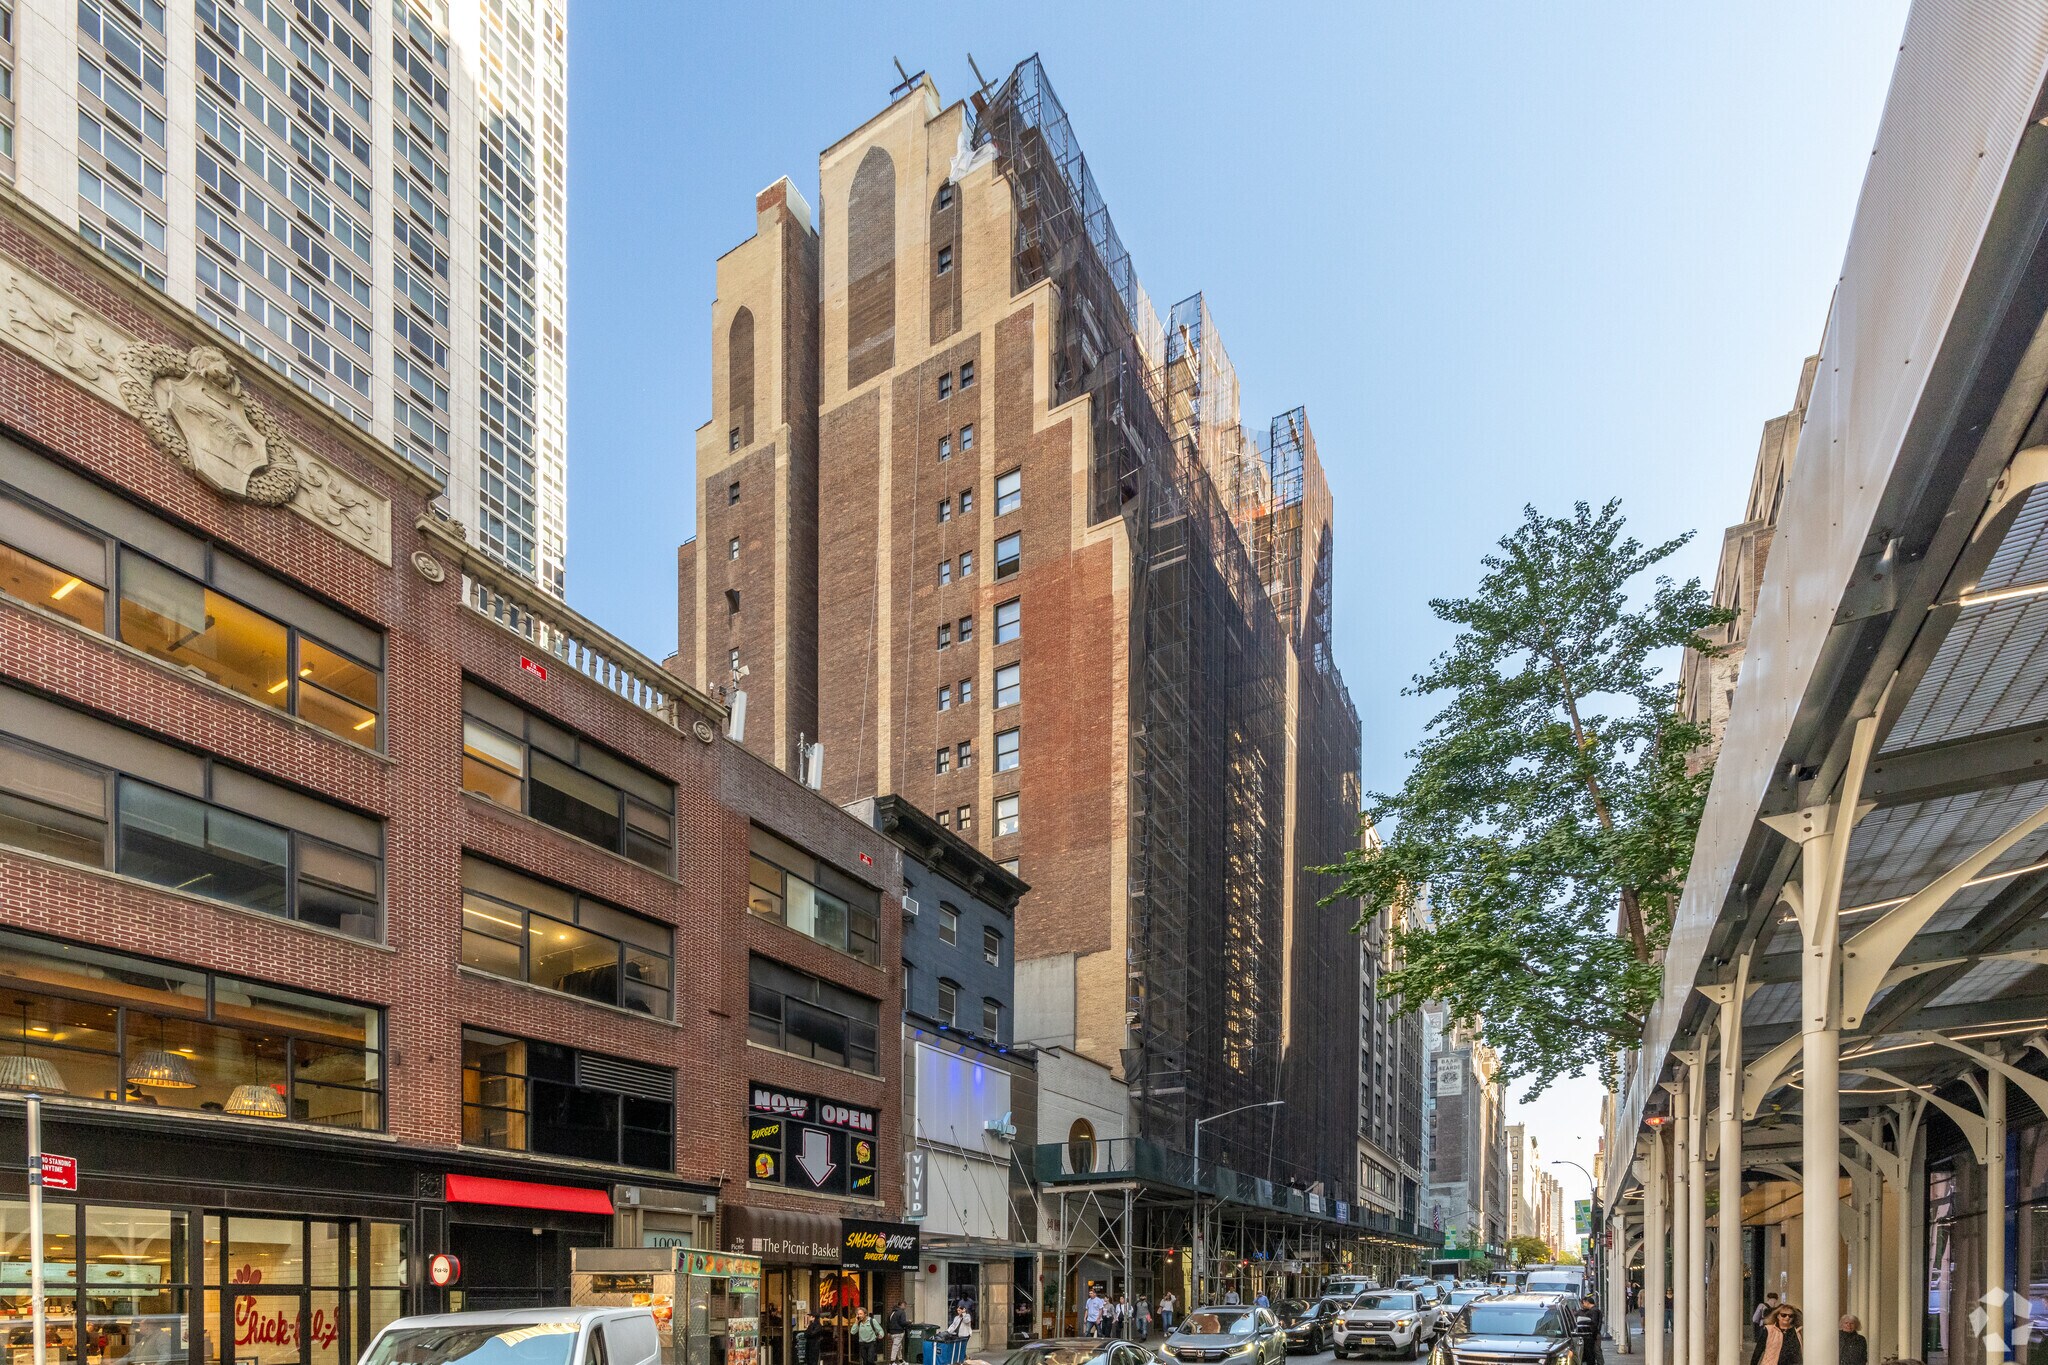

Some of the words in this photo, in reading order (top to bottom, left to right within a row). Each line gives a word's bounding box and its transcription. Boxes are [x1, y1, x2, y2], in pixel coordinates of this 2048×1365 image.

[754, 1090, 808, 1118] NOW
[821, 1104, 873, 1132] OPEN
[751, 1124, 779, 1140] BURGERS
[42, 1164, 63, 1173] ANYTIME
[49, 1158, 72, 1167] STANDING
[857, 1174, 872, 1188] MORE
[912, 1154, 923, 1212] VIVID
[653, 1237, 682, 1248] 1000
[763, 1238, 780, 1253] The
[782, 1240, 810, 1256] Picnic
[812, 1242, 839, 1258] Basket
[845, 1231, 878, 1249] SMASH
[886, 1234, 917, 1250] HOUSE
[864, 1252, 884, 1261] BURGERS
[887, 1254, 900, 1262] MORE
